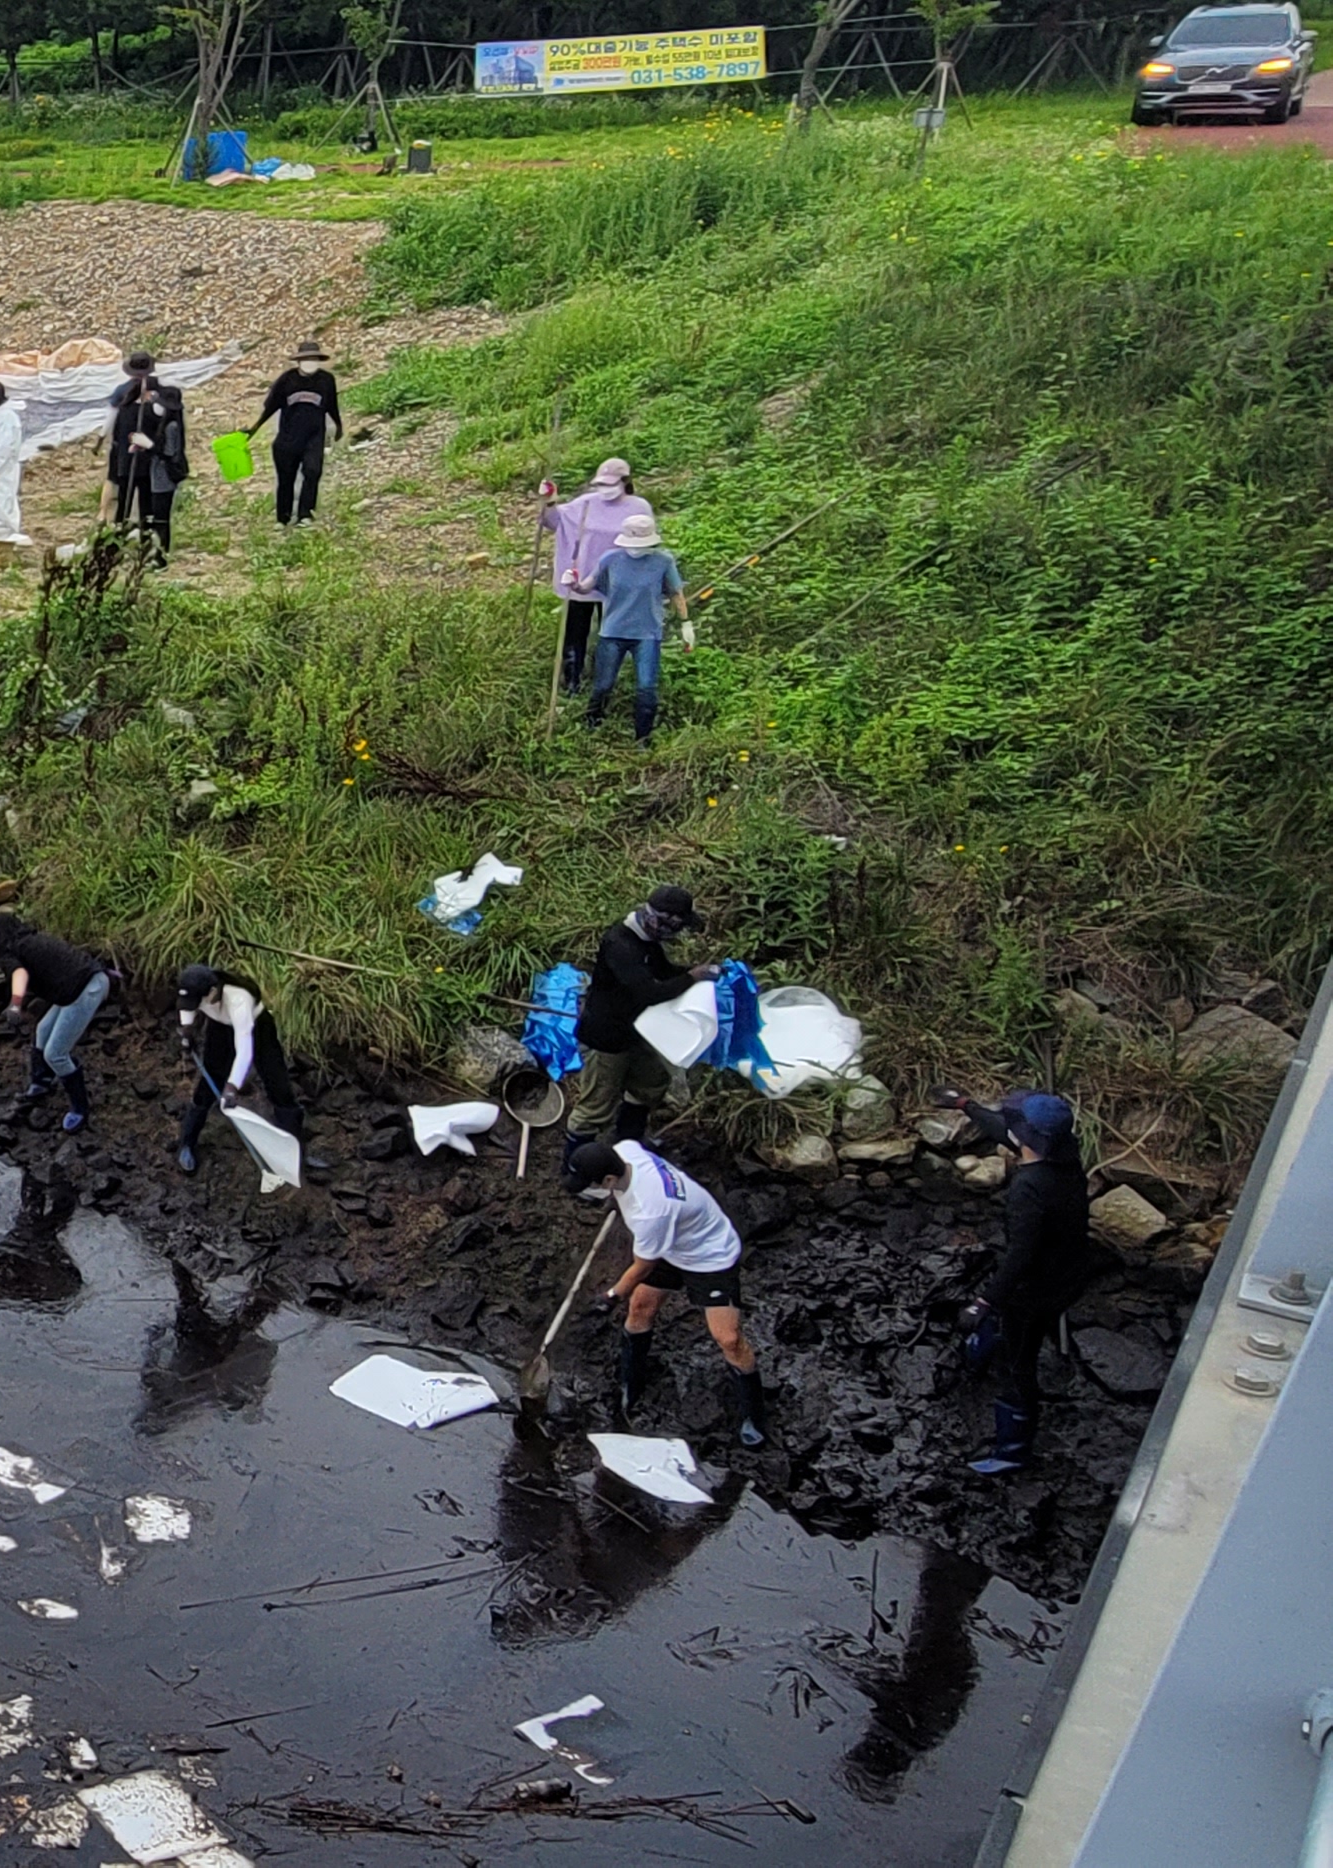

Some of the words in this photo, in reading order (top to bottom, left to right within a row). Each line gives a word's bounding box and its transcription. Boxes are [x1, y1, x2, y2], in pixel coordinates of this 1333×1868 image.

[549, 39, 649, 57] 90%대출기능
[655, 35, 703, 50] 주택수
[709, 31, 758, 46] 미포함
[631, 61, 761, 85] 031-538-7897
